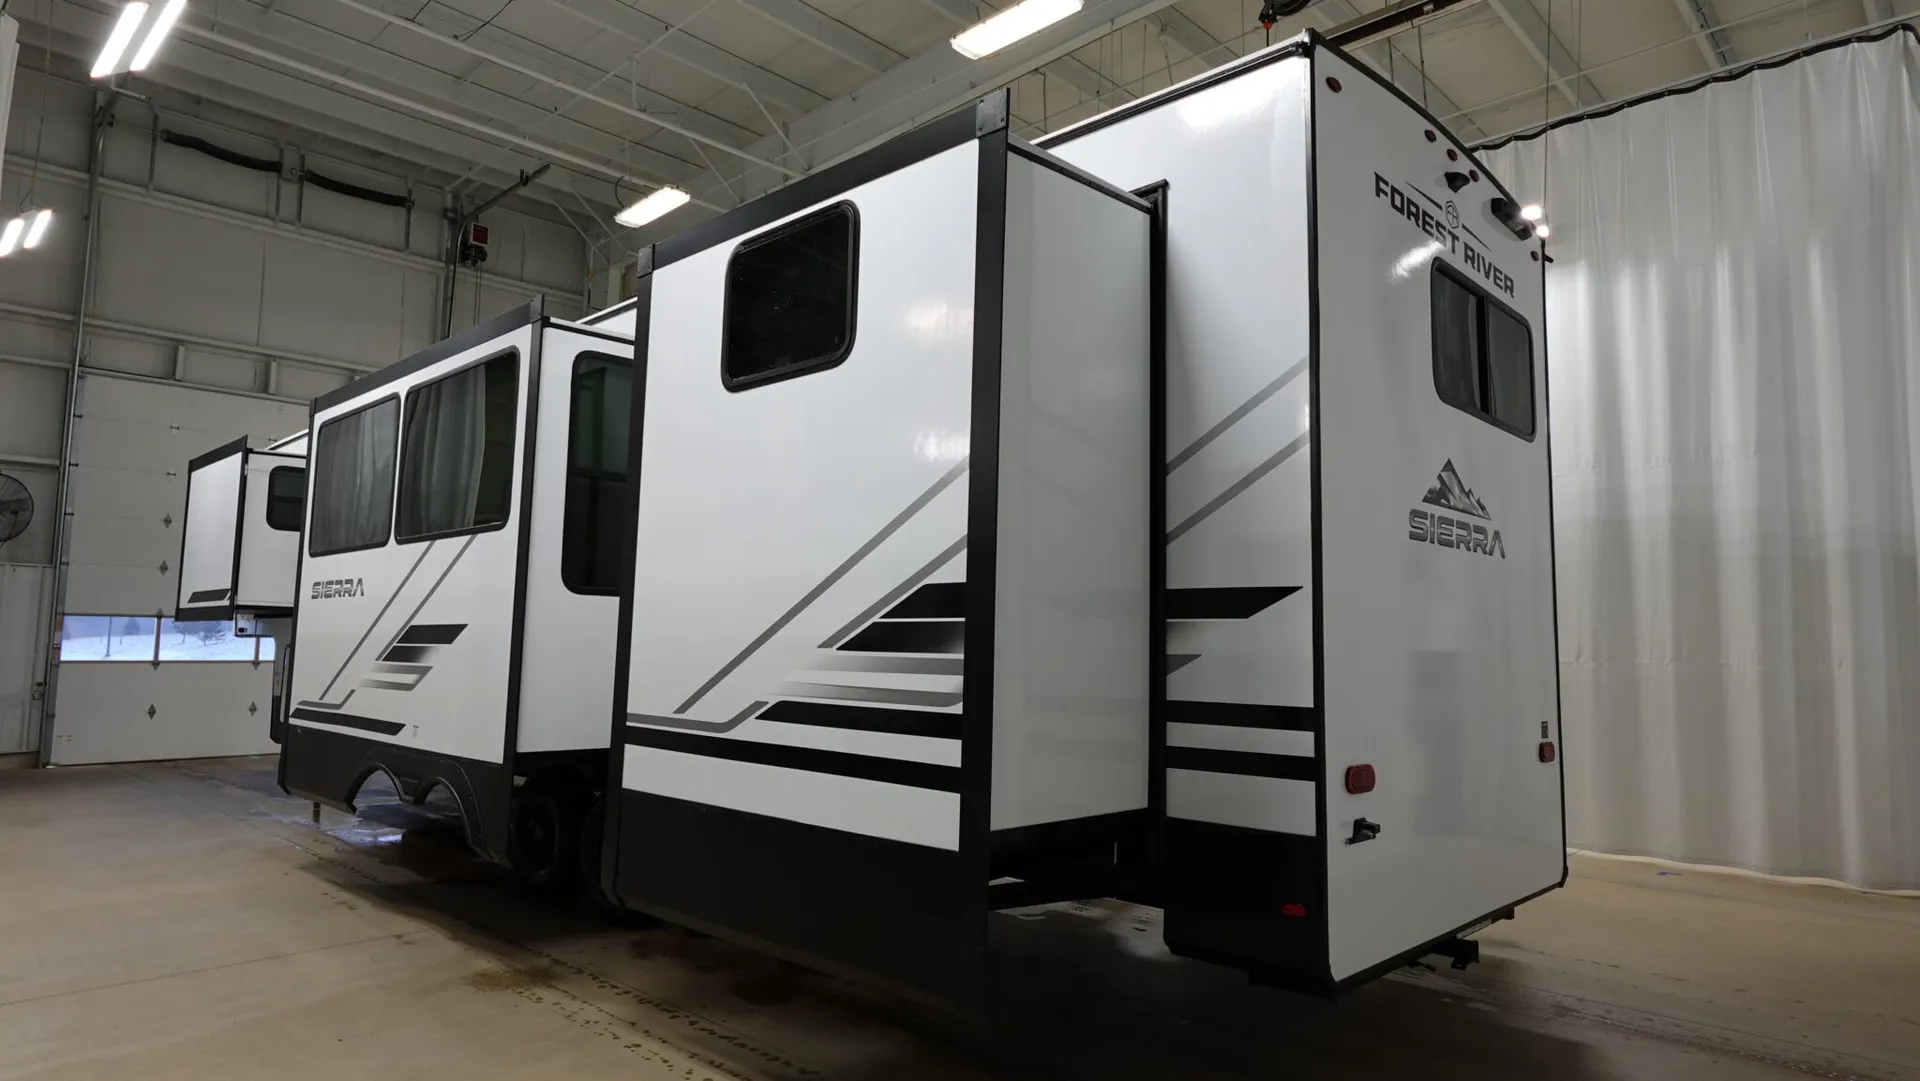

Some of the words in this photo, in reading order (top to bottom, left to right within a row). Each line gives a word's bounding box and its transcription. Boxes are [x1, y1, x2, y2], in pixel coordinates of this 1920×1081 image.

[1373, 171, 1459, 254] FOREST
[1463, 241, 1515, 298] RIVER
[1409, 508, 1506, 559] SIERRA
[311, 578, 364, 600] SIERRA
